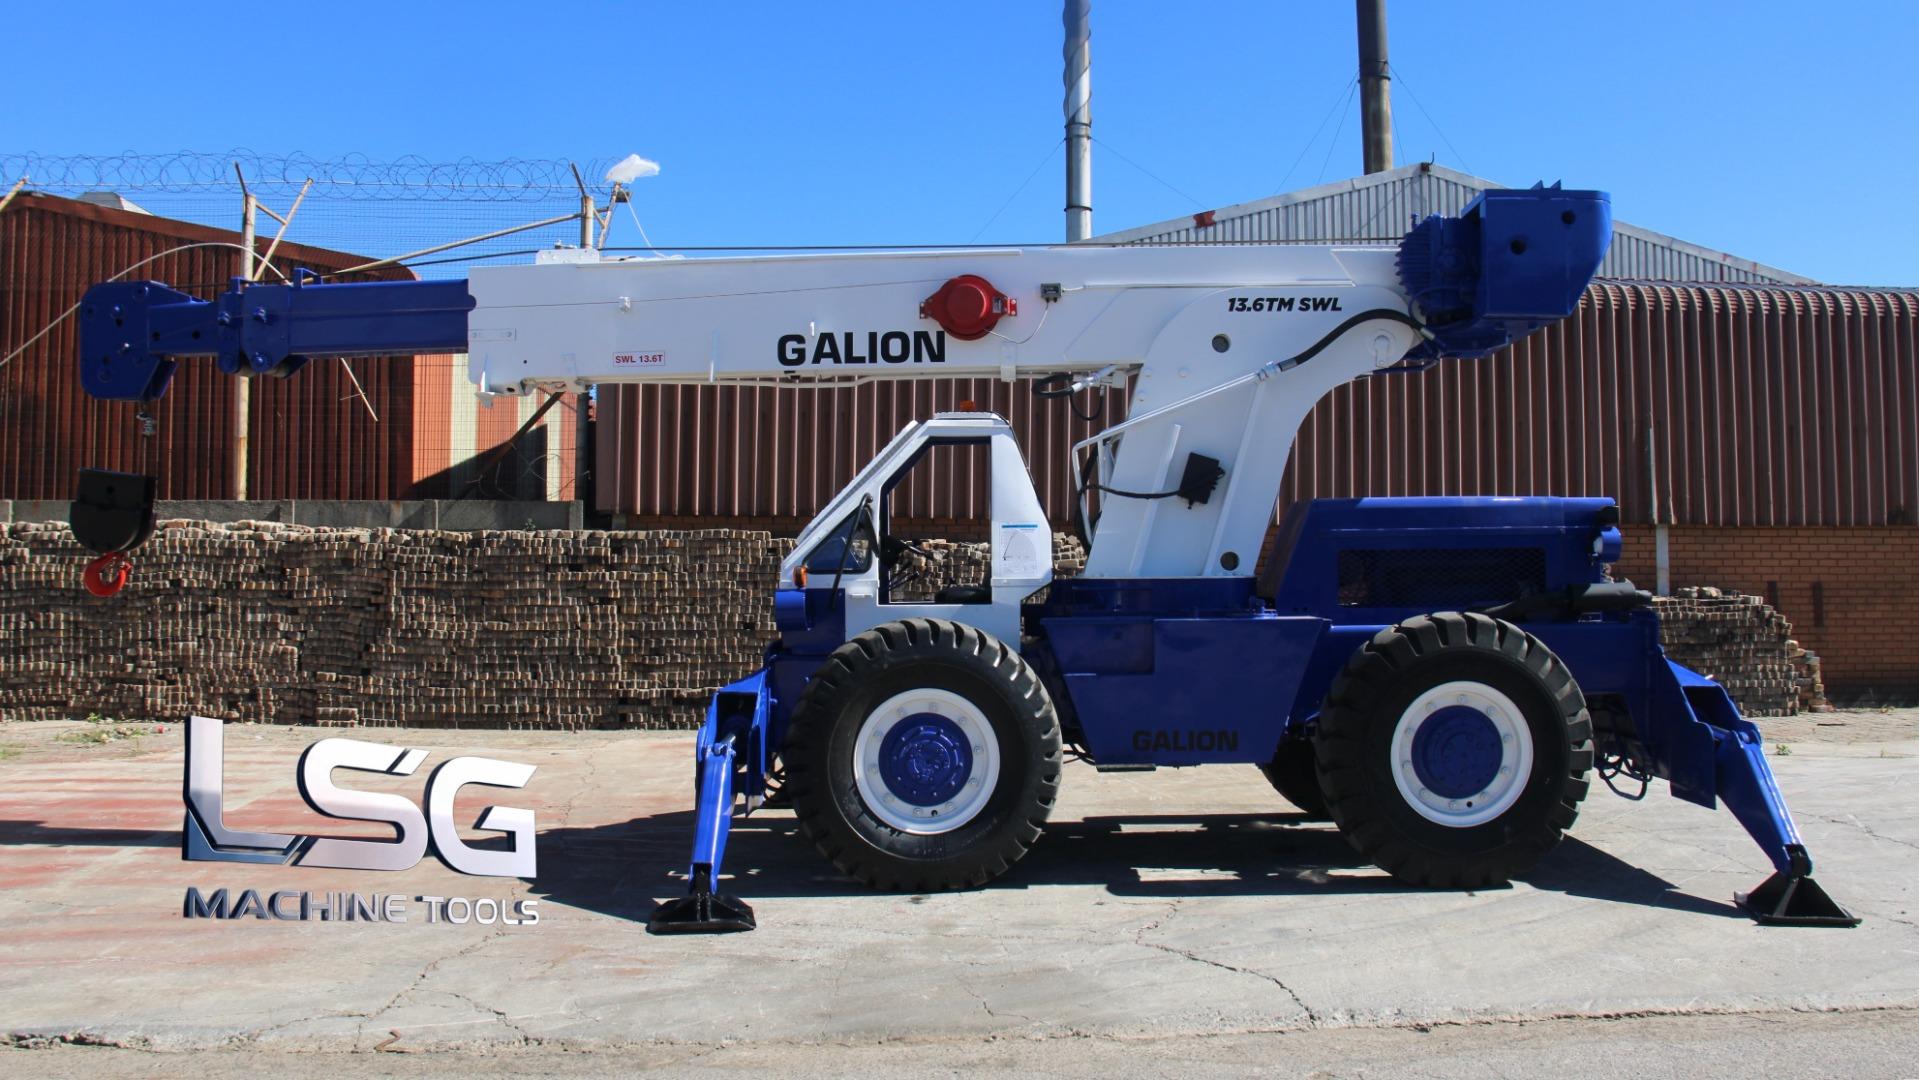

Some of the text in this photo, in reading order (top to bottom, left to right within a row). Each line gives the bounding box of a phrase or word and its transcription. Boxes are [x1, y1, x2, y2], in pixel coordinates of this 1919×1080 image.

[1228, 297, 1342, 312] 13.6TM SWL
[777, 330, 946, 367] GALION
[615, 354, 663, 364] SWL 13.6T
[1132, 730, 1239, 752] GALION
